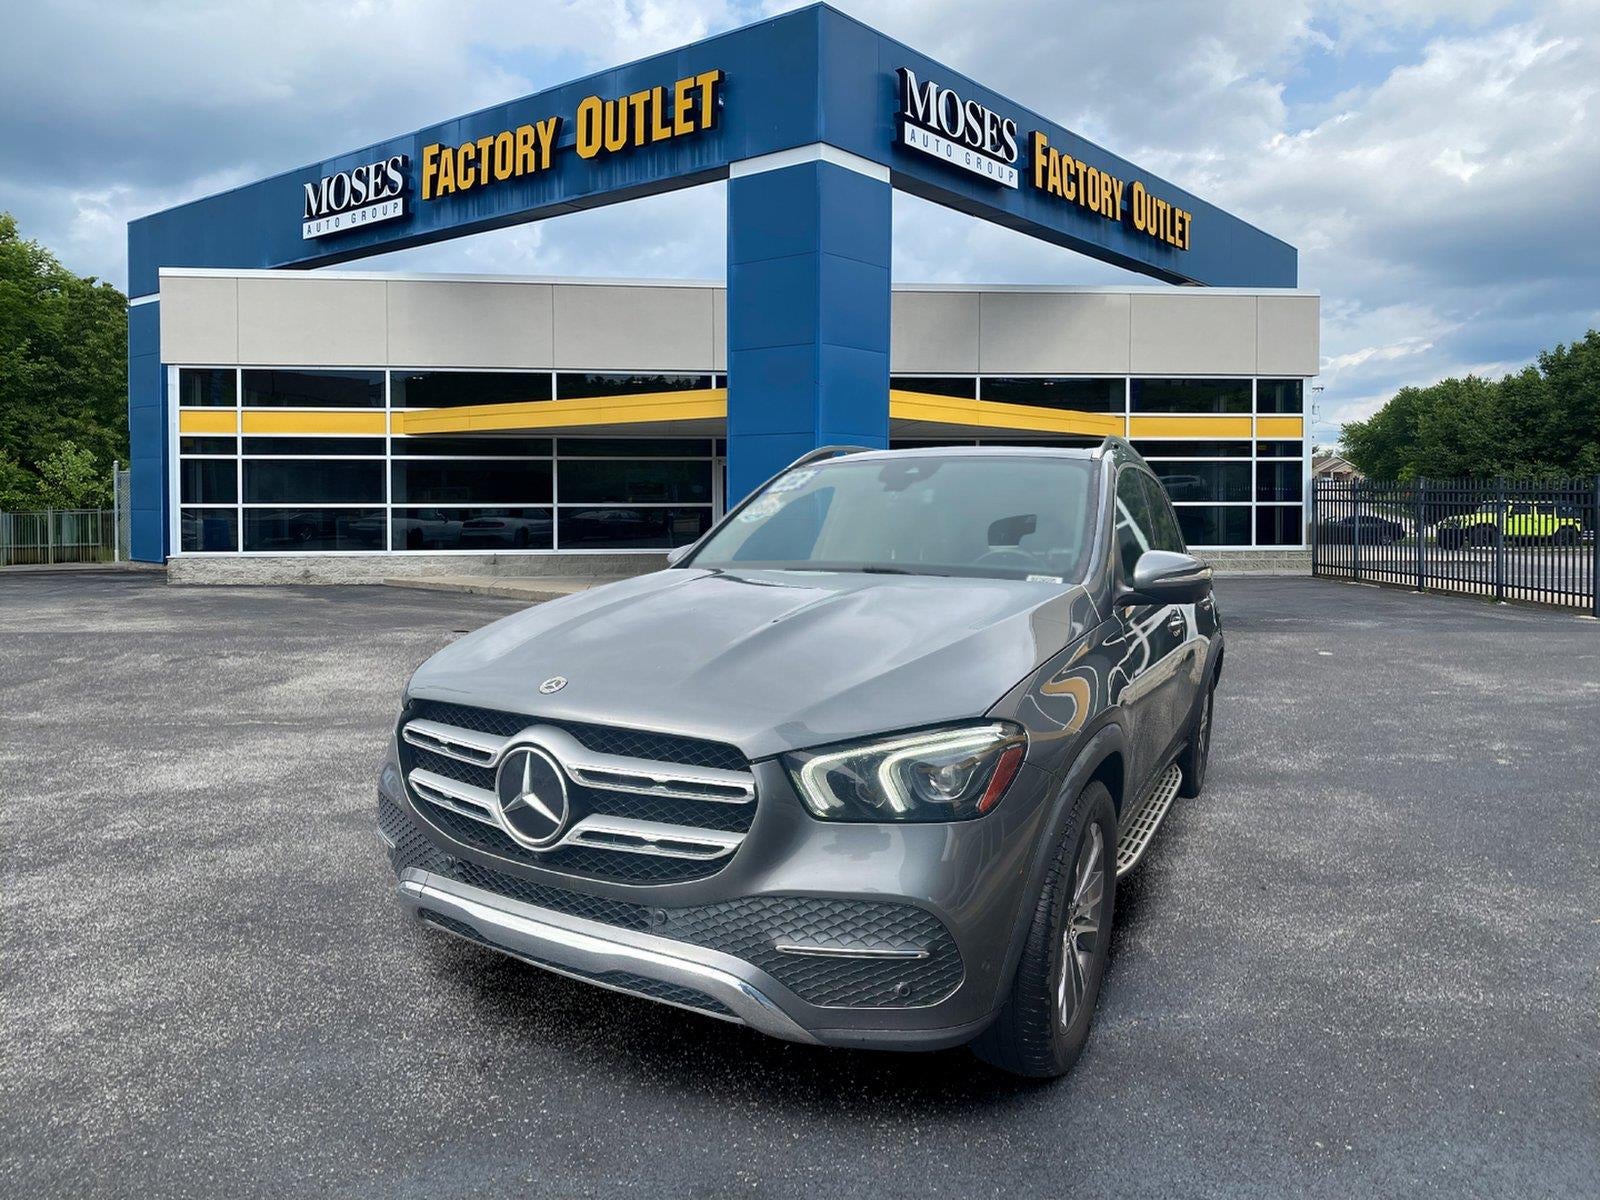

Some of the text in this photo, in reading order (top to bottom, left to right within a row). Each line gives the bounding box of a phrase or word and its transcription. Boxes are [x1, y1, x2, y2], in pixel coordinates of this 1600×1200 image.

[422, 69, 720, 200] FACTORY OUTLET
[904, 67, 1018, 164] MOSES
[909, 128, 1014, 183] AUTO GROUP
[303, 156, 404, 219] MOSES
[307, 202, 400, 236] AUTO GROUP
[1034, 130, 1192, 250] FACTORY OUTLET
